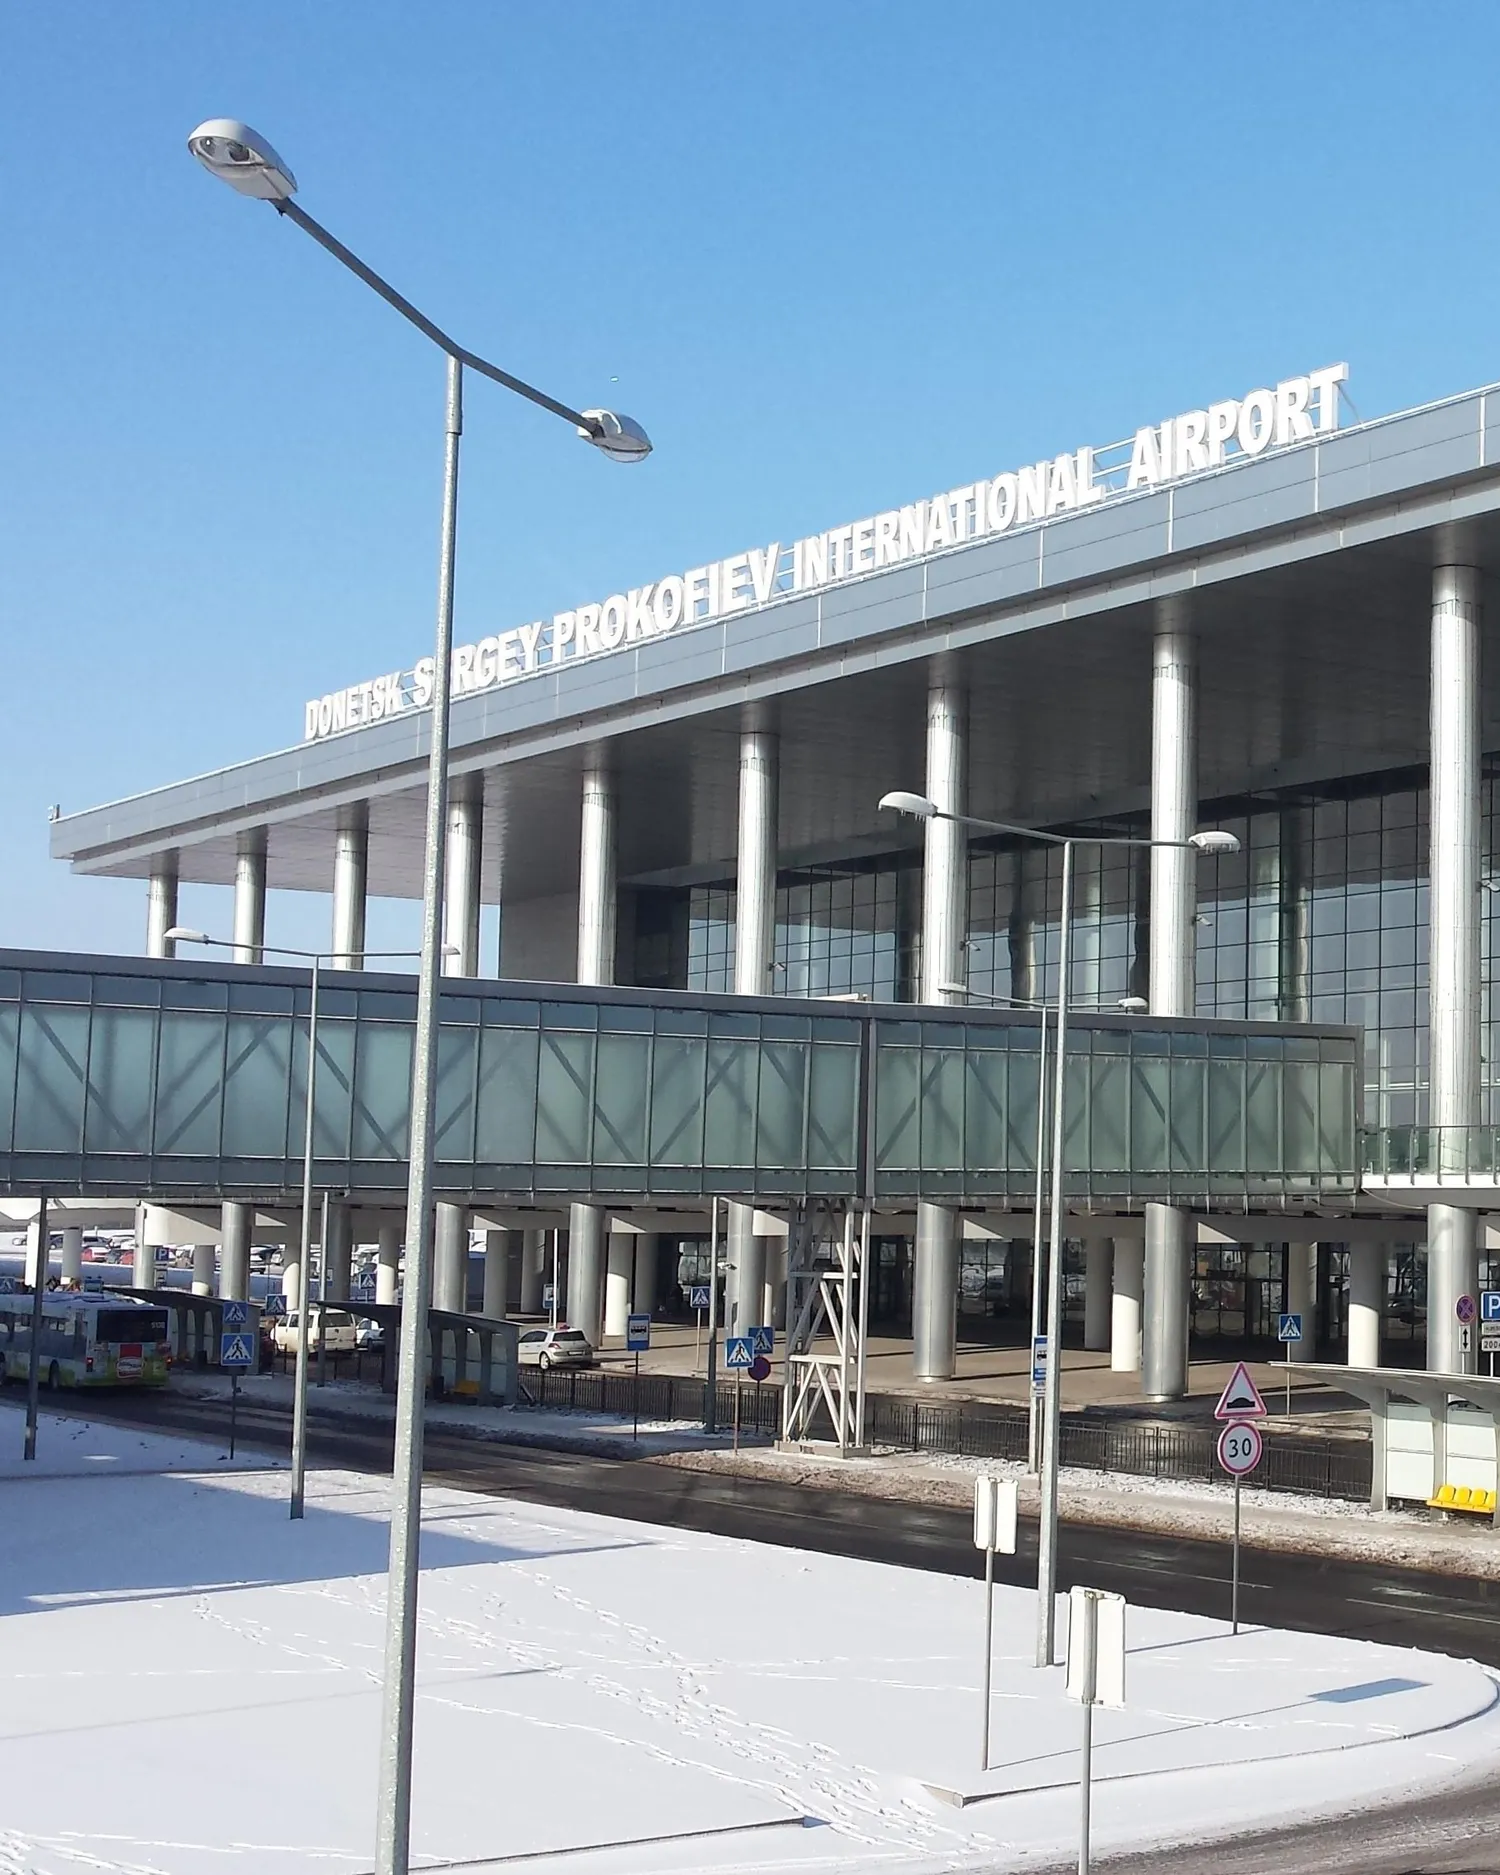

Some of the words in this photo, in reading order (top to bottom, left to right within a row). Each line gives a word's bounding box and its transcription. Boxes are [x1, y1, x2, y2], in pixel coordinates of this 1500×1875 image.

[304, 671, 404, 741] DONETSK
[413, 621, 542, 706] SRGEY
[552, 542, 780, 664] PROKOFIEV
[793, 445, 1106, 591] INTERNATIONAL
[1127, 361, 1349, 490] AIRPORT
[1228, 1437, 1252, 1458] 30
